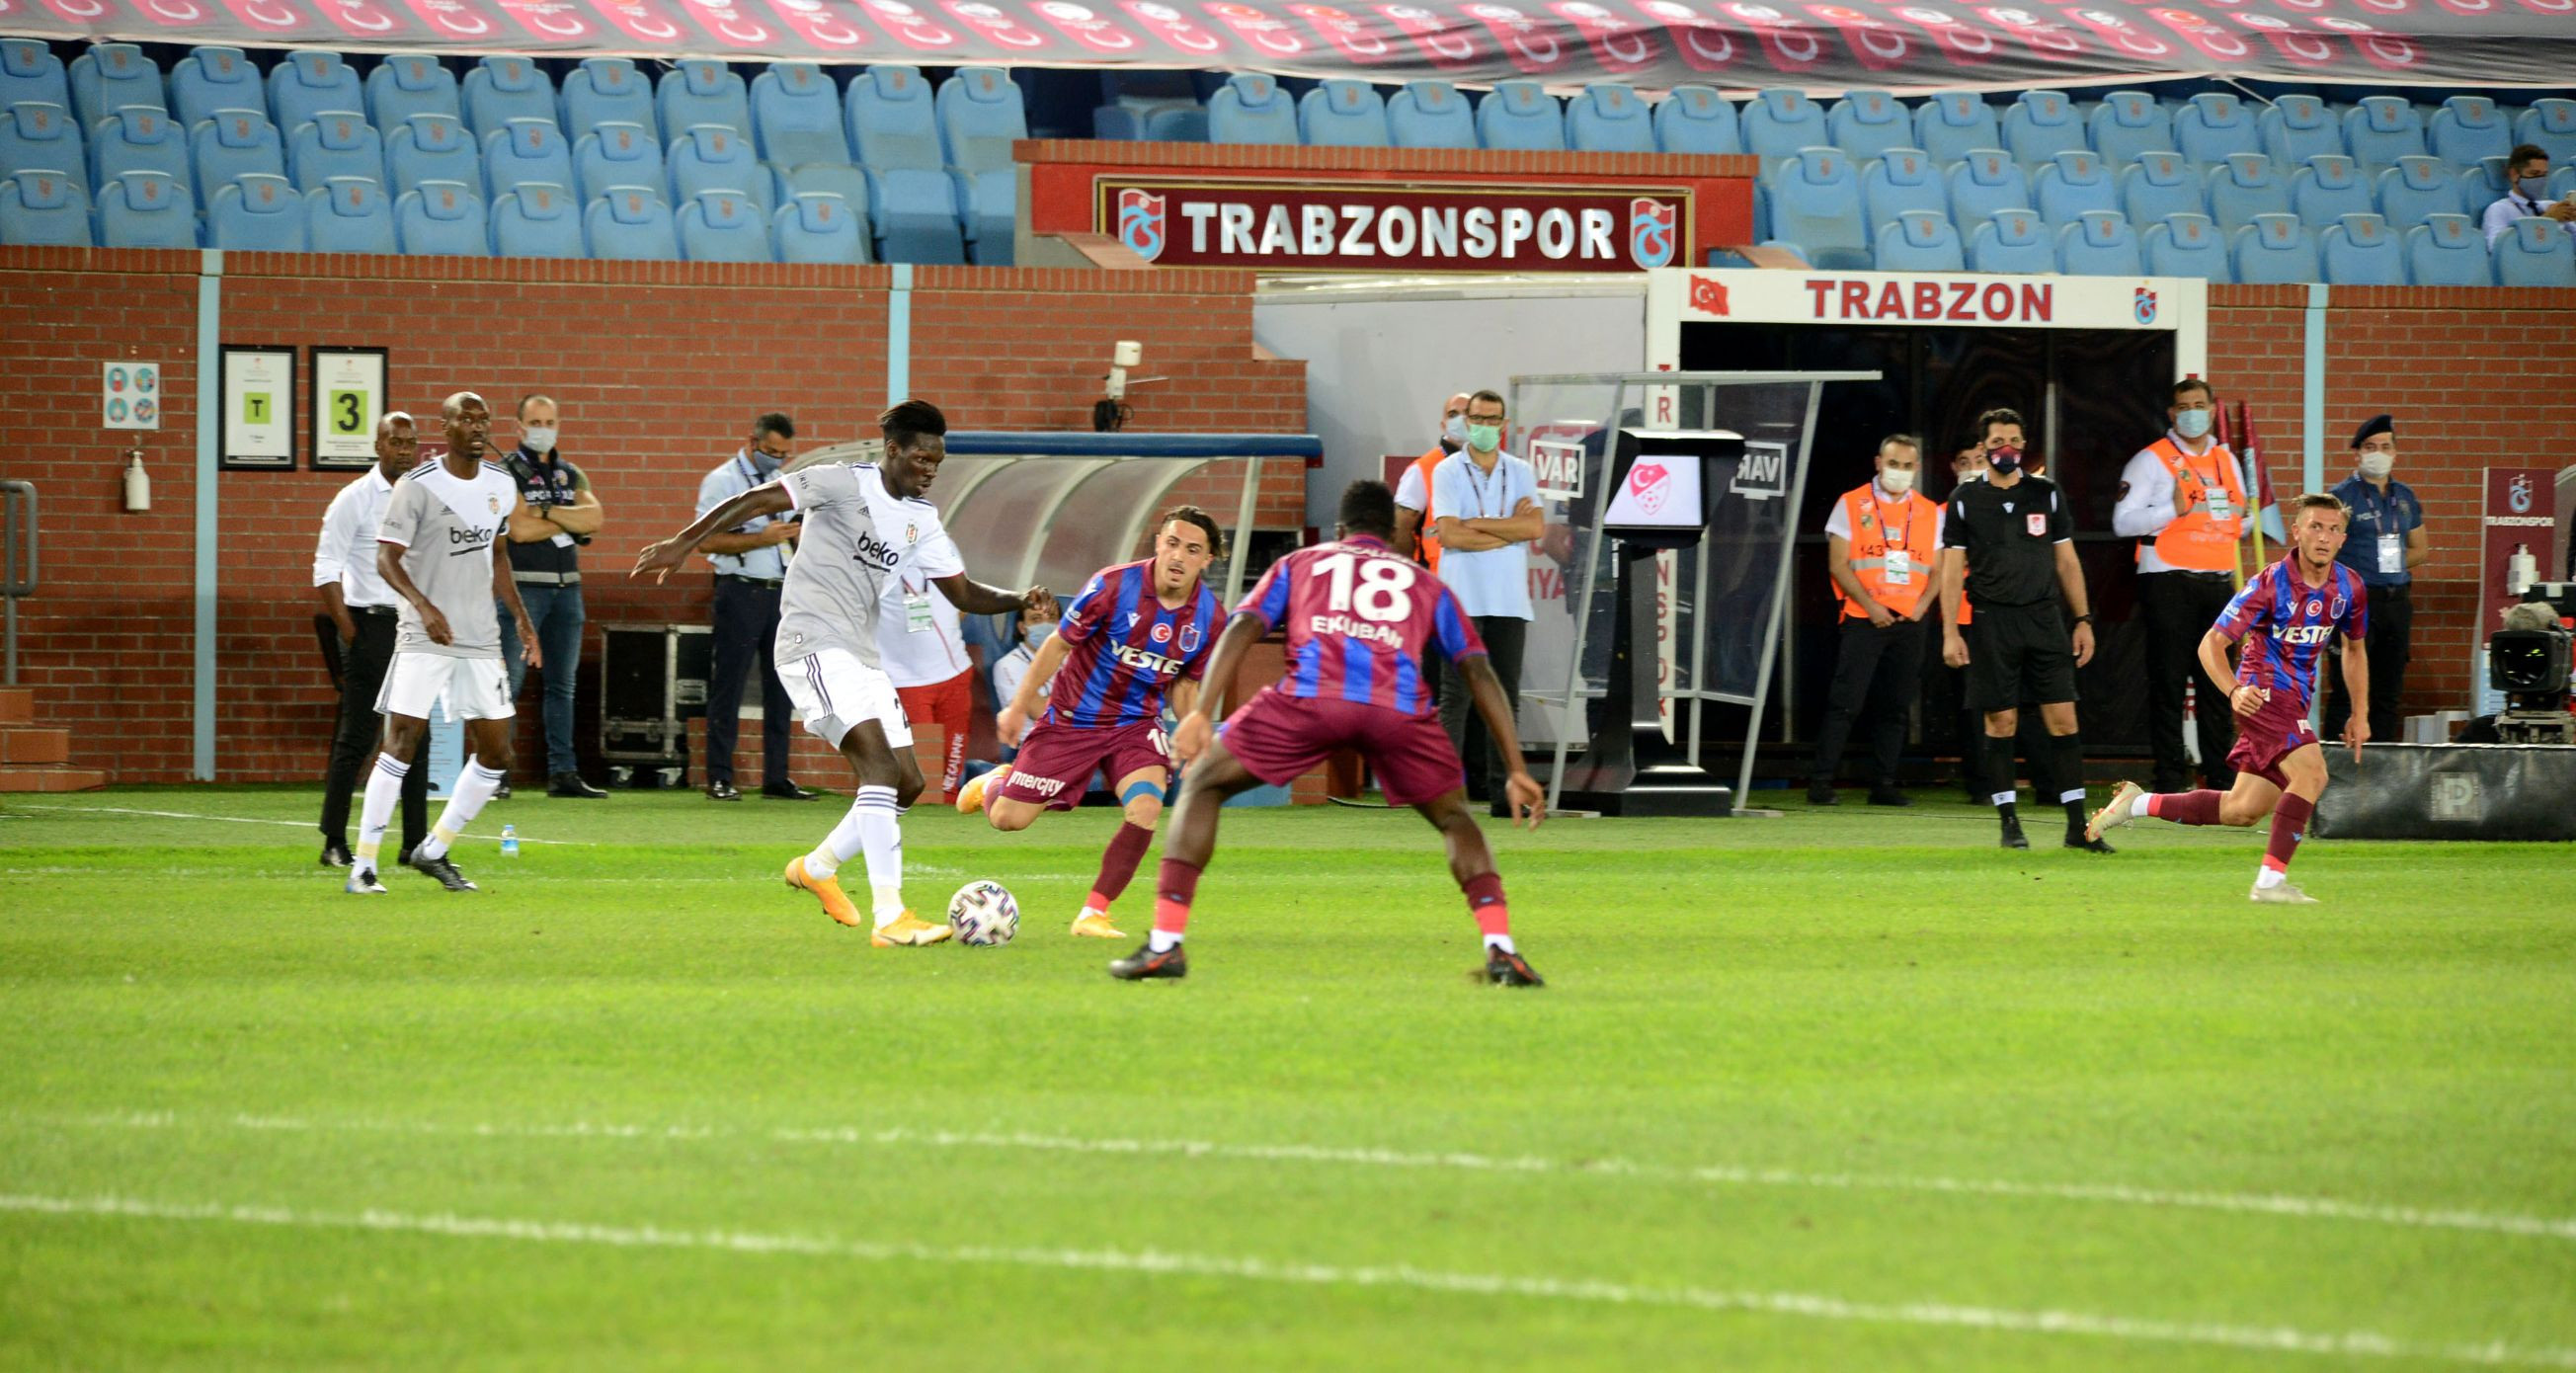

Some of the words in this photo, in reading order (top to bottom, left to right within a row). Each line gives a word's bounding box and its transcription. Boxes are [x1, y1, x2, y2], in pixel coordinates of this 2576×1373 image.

[1181, 202, 1617, 259] TRABZONSPOR
[1806, 280, 2053, 322] TRABZON
[251, 399, 264, 417] T
[338, 393, 360, 432] 3
[1537, 454, 1578, 483] VAR
[449, 525, 493, 544] beko
[857, 530, 899, 566] beko
[1312, 553, 1415, 622] 18
[1311, 615, 1404, 649] EKUBAN
[1006, 770, 1066, 797] intercity
